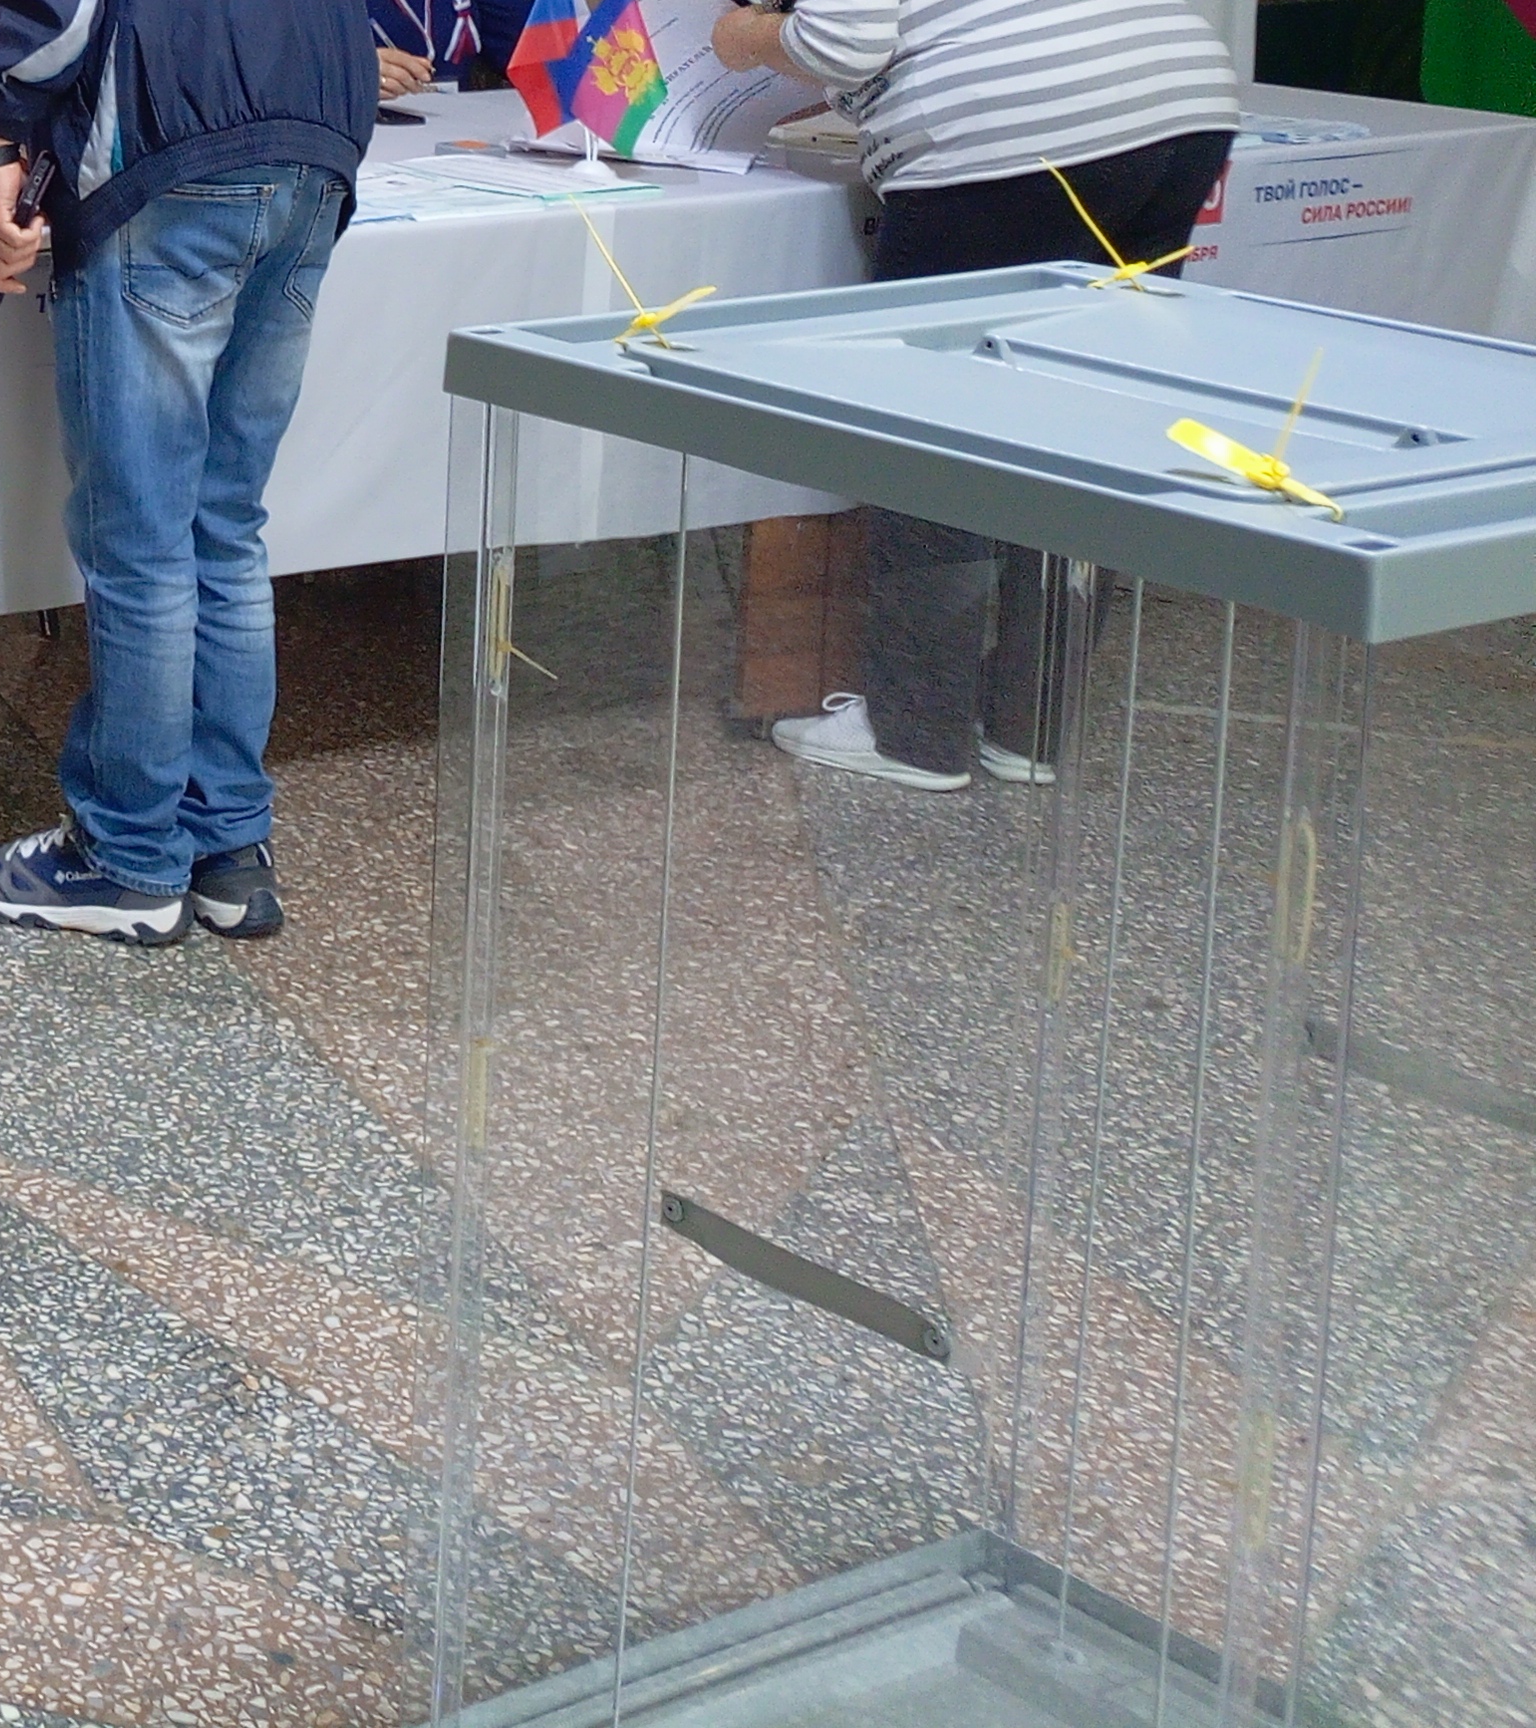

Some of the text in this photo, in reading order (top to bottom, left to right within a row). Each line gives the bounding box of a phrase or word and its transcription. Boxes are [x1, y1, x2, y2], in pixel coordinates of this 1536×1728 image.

[1254, 180, 1295, 203] ТВОЙ
[1300, 180, 1348, 199] ГОЛОС
[1301, 198, 1410, 224] СИЛА РОССИИ!
